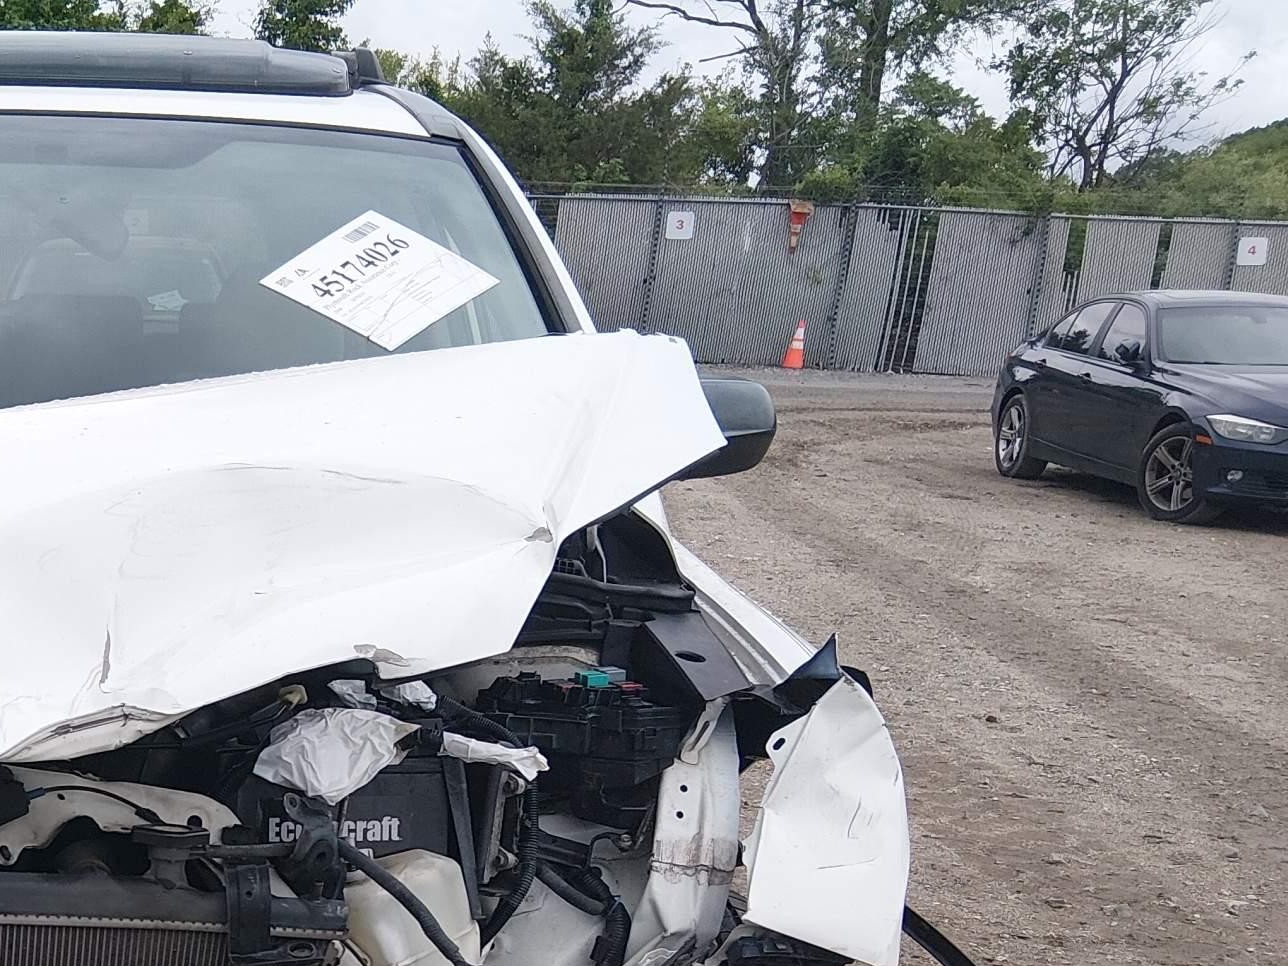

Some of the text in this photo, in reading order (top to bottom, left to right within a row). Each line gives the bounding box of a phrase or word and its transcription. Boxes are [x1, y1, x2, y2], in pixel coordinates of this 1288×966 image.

[675, 219, 685, 230] 3
[1247, 245, 1257, 256] 4
[311, 232, 410, 298] 45174026
